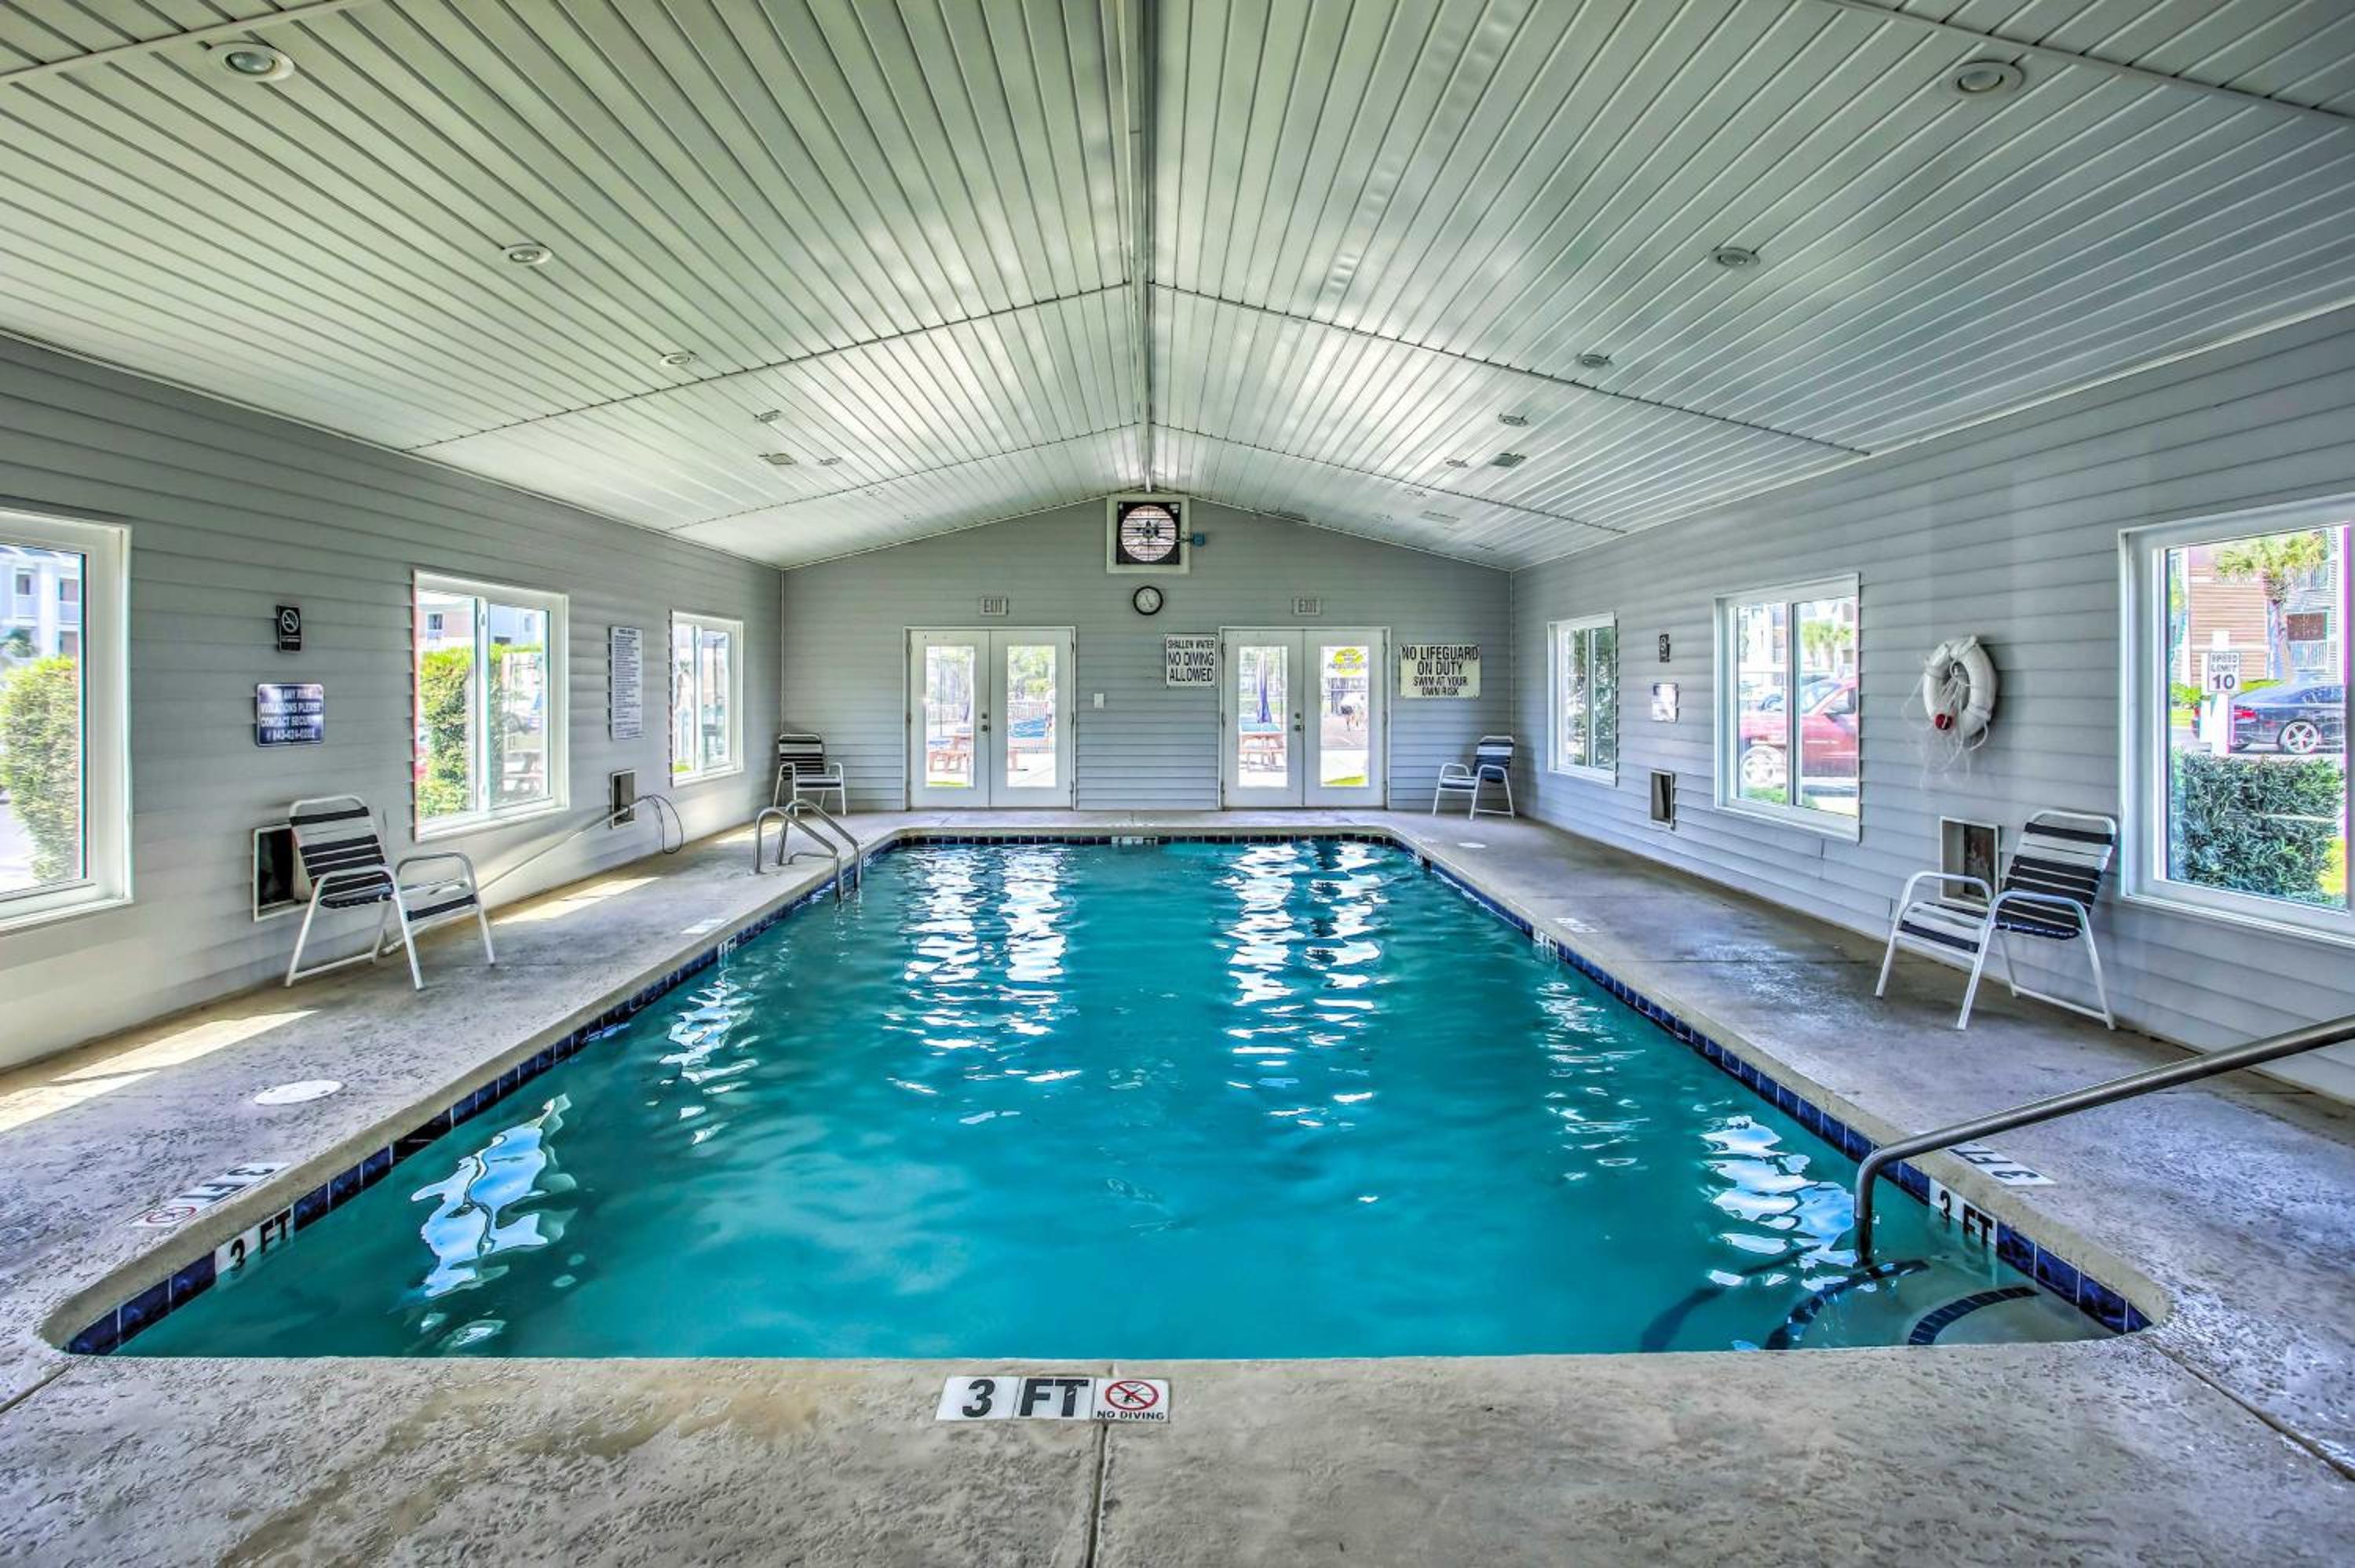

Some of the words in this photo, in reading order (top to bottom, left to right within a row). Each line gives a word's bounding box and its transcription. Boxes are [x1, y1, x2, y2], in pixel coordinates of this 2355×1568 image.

[984, 599, 1002, 612] EXIT
[1298, 599, 1317, 612] EXIT
[1168, 652, 1181, 665] NO
[1184, 651, 1214, 666] DIVING
[1403, 646, 1417, 659] NO
[1420, 646, 1478, 660] LIFEGUARD
[1170, 669, 1213, 681] ALLOWED
[1418, 661, 1432, 675] ON
[1436, 661, 1463, 675] DUTY
[1413, 676, 1433, 686] SWIM
[1436, 676, 1445, 685] AT
[1447, 676, 1468, 686] YOUR
[2213, 674, 2235, 689] 10
[1948, 1148, 2013, 1164] FT
[1992, 1170, 2039, 1179] 3
[260, 1209, 291, 1256] FT
[1963, 1204, 1993, 1248] FT
[962, 1379, 995, 1418] 3
[1019, 1378, 1089, 1417] FT
[1120, 1410, 1164, 1420] DIVING
